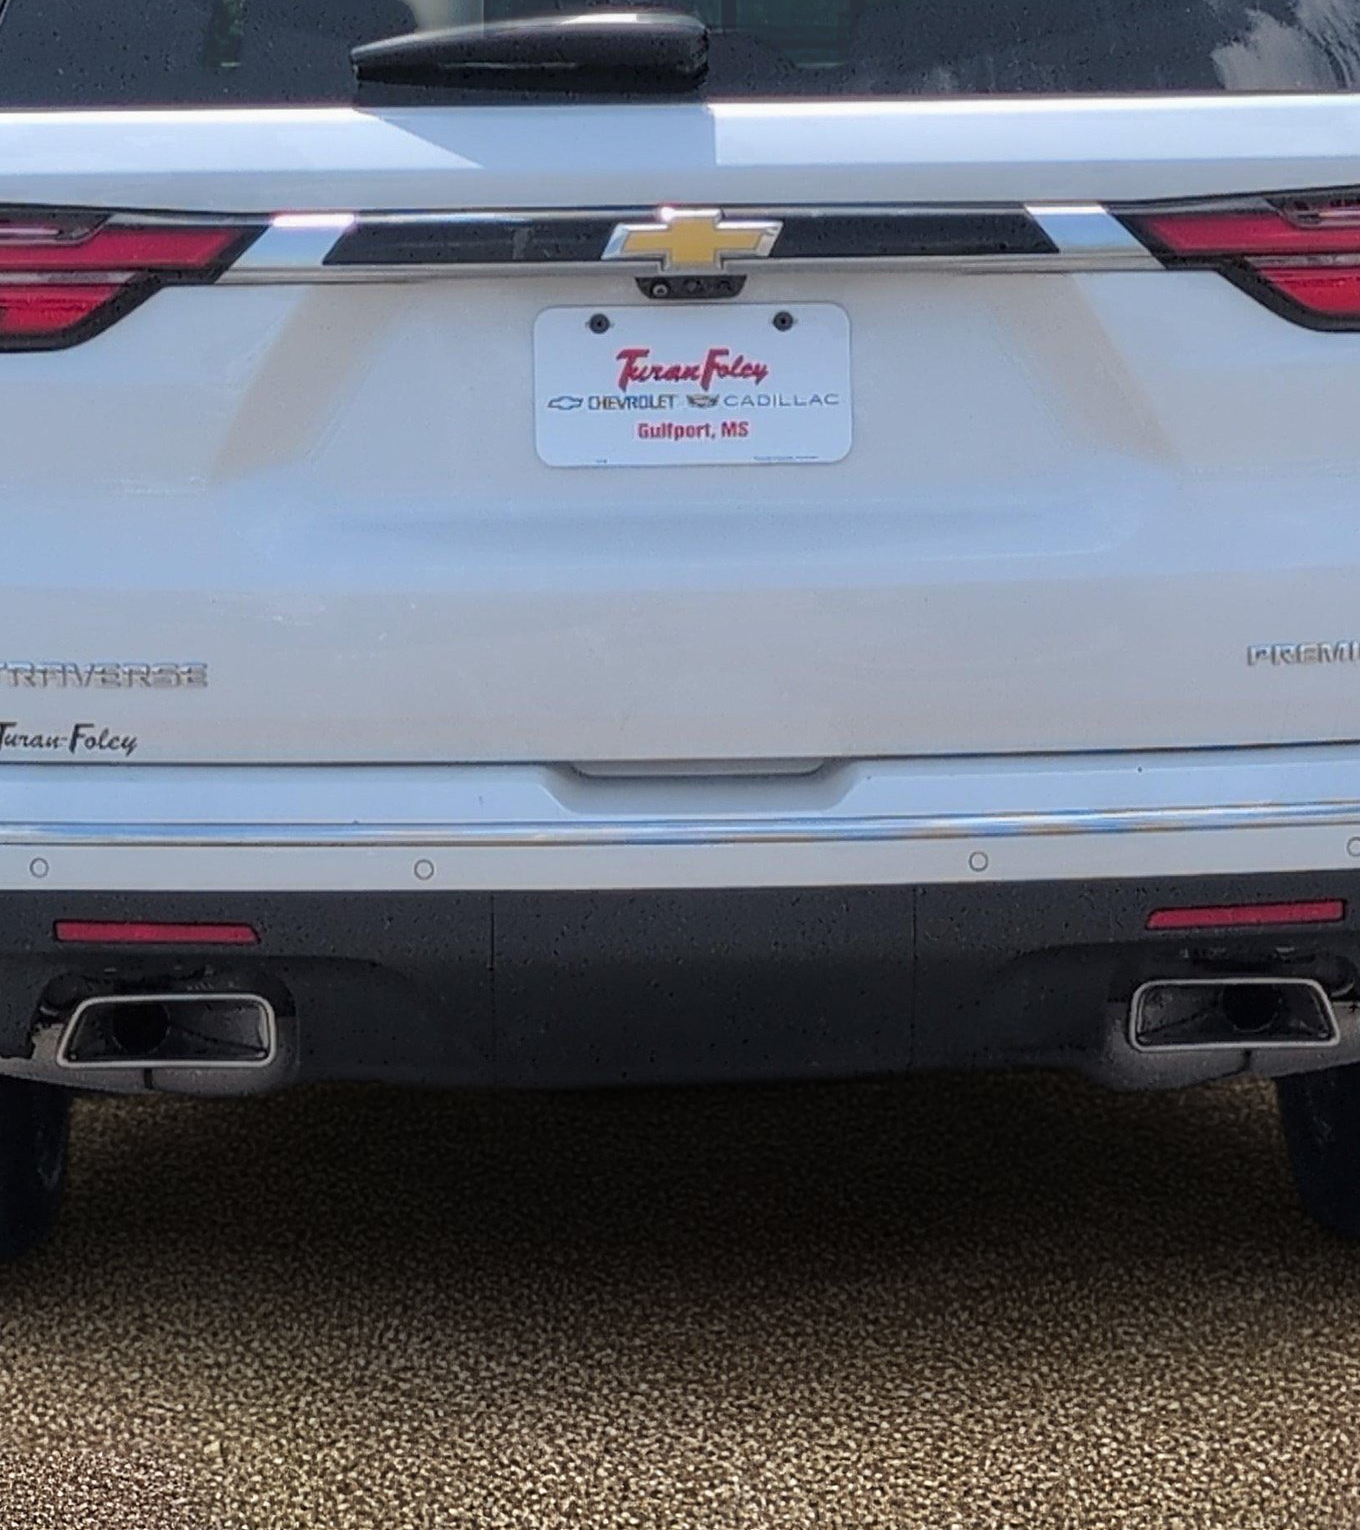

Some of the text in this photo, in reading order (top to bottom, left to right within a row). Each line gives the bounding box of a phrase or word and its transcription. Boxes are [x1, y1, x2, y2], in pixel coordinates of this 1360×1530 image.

[588, 393, 839, 410] CHEVROLET CADILLAC
[638, 421, 750, 441] Gulfport, MS
